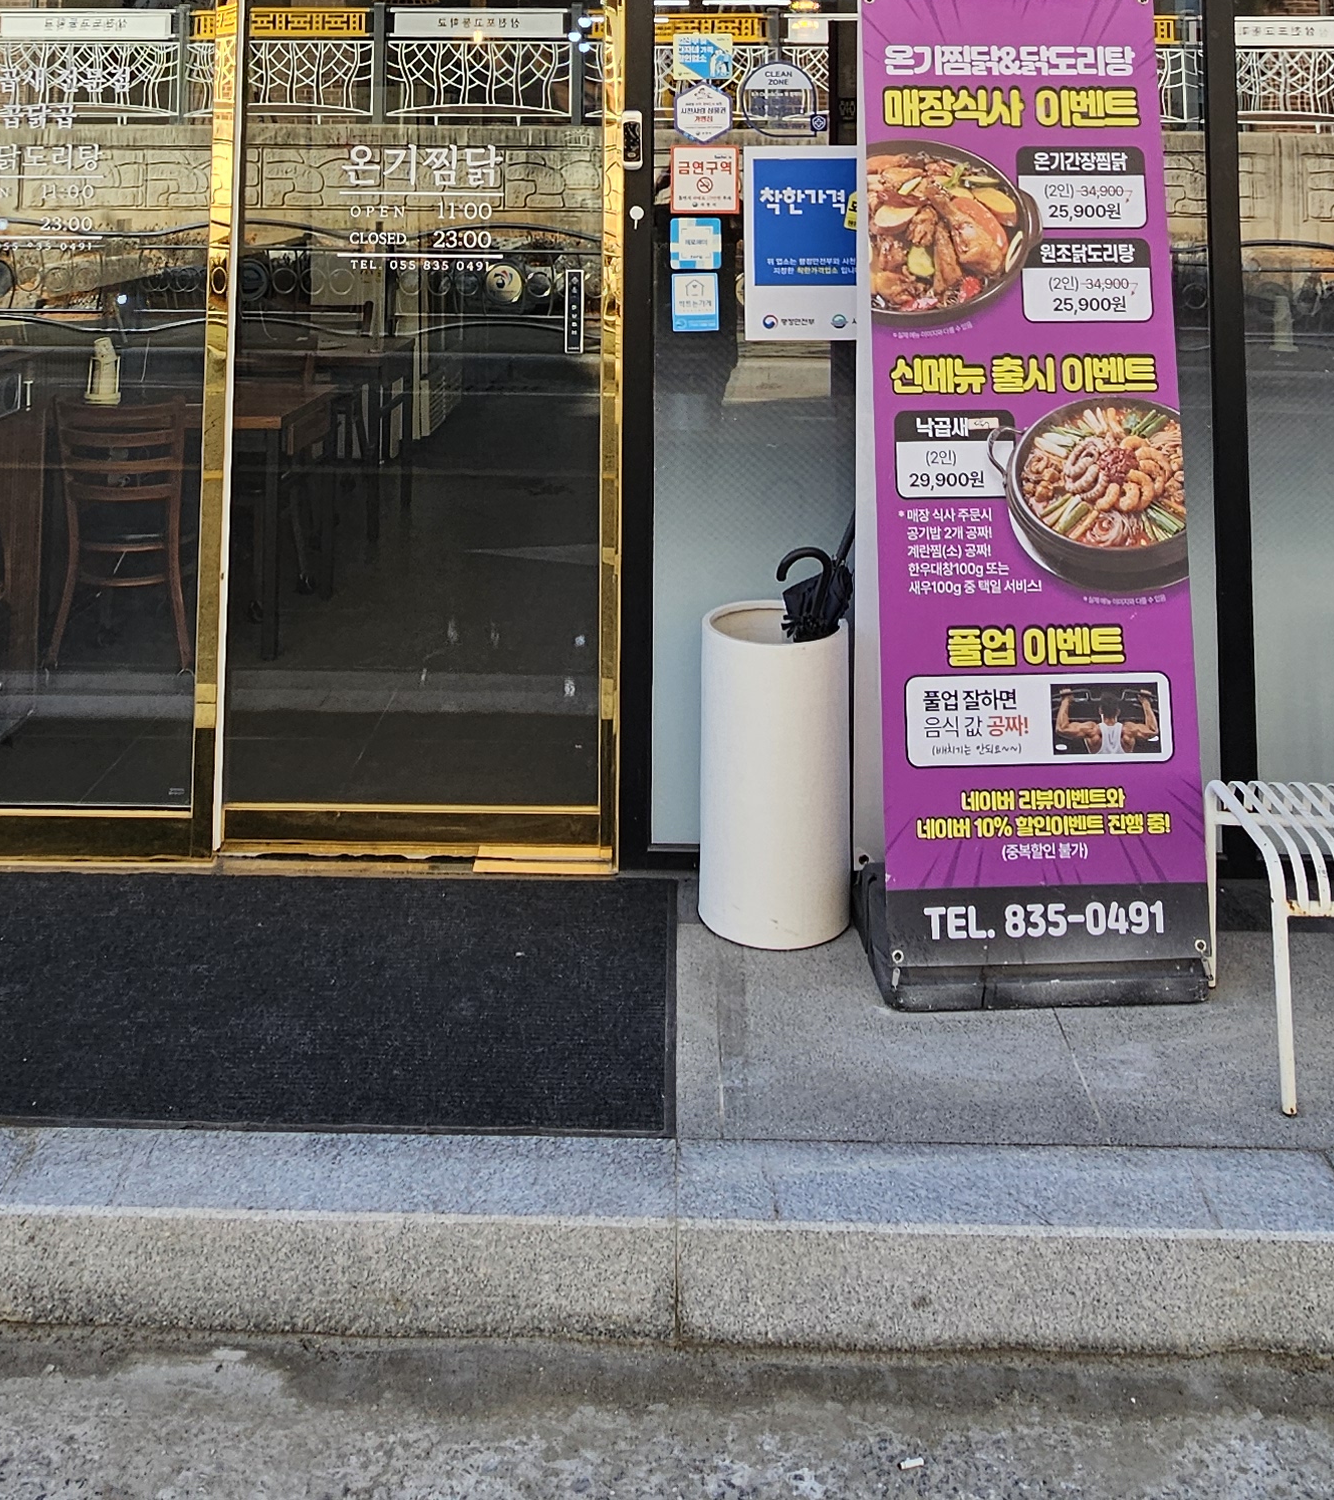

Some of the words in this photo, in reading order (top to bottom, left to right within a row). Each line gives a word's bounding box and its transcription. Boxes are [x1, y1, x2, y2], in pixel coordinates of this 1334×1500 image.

[884, 45, 1135, 76] 온기찜닭&닭도리탕
[58, 66, 131, 93] 전문점
[883, 86, 1025, 127] 매장식사
[1034, 86, 1141, 127] 이벤트
[342, 143, 503, 187] 온기찜닭
[678, 160, 733, 175] 금연구역
[1033, 151, 1128, 171] 온기간장찜닭
[41, 184, 95, 200] 11:00
[759, 186, 846, 215] 착한가격
[1044, 183, 1075, 199] (2인)
[1080, 185, 1124, 199] 34,900
[350, 205, 405, 218] OPEN
[437, 202, 493, 220] 11:00
[1048, 203, 1122, 222] 25,900원
[39, 216, 94, 232] 23:00
[60, 241, 93, 251] 0491
[349, 231, 407, 246] CLOSED
[432, 230, 493, 249] 23:00
[1040, 243, 1135, 263] 원조닭도리탕
[389, 260, 417, 271] 055
[423, 260, 450, 271] 835
[456, 260, 491, 272] 0491
[841, 267, 857, 275] 입니
[1048, 276, 1079, 292] (2인)
[1085, 278, 1130, 292] 34,900
[1053, 296, 1127, 315] 25,900원
[890, 355, 987, 394] 신메뉴
[991, 354, 1056, 394] 출시
[1060, 354, 1158, 393] 이벤트
[915, 417, 969, 438] 낙곱새
[925, 451, 957, 466] (2인)
[908, 470, 985, 491] 29,900원
[907, 508, 929, 522] 매장
[932, 508, 955, 522] 식사
[958, 508, 992, 522] 주문시
[907, 527, 941, 541] 공기밥
[944, 526, 964, 540] 2개
[966, 526, 993, 540] 공짜!
[907, 544, 962, 559] 계란찜(소)
[965, 544, 991, 557] 공짜!
[908, 562, 983, 577] 한우대창100g
[986, 562, 1009, 575] 또는
[909, 580, 961, 595] 새우100g
[964, 580, 976, 594] 중
[978, 580, 1001, 594] 택일
[1004, 579, 1043, 593] 서비스!
[947, 625, 1016, 667] 풀업
[1022, 624, 1126, 665] 이벤트
[923, 689, 959, 712] 풀업
[962, 688, 1017, 711] 잘하면
[924, 716, 959, 738] 음식
[964, 715, 983, 737] 값
[986, 715, 1029, 737] 공짜!
[932, 743, 971, 756] (배치기는
[961, 789, 1015, 812] 네이버
[1018, 786, 1126, 811] 리뷰이벤트와
[916, 816, 971, 840] 네이버
[973, 814, 1012, 838] 10%
[1015, 813, 1105, 837] 할인이벤트
[1107, 812, 1144, 835] 진행
[1146, 812, 1171, 834] 중!
[1001, 844, 1056, 861] (중복할인
[1058, 843, 1088, 860] 불가)
[923, 905, 996, 940] TEL.
[1004, 900, 1165, 938] 835-0491
